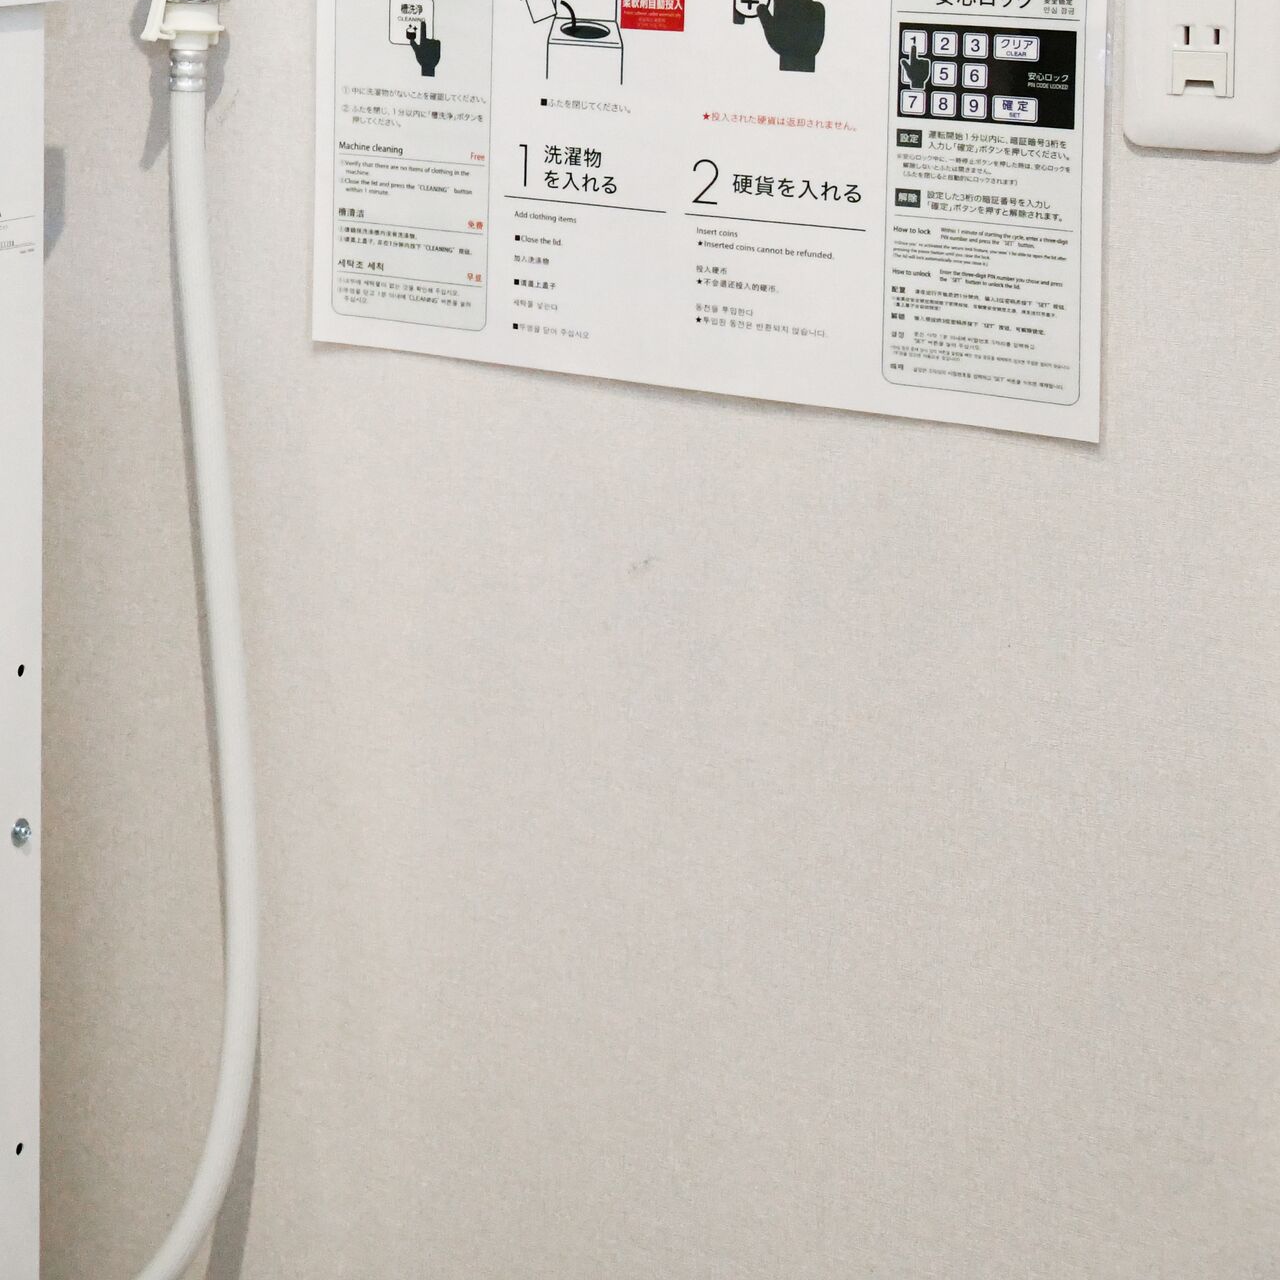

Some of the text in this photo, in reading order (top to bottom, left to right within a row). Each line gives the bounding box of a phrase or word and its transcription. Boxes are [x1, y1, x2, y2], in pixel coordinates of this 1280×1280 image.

[941, 38, 949, 51] 2
[970, 39, 980, 52] 3
[1001, 39, 1033, 50] クリア
[939, 67, 979, 82] 5 6
[1028, 72, 1069, 82] 安心ロック
[908, 95, 1029, 113] 7 8 9 確定
[339, 141, 485, 162] Machine cleaning Free
[519, 144, 602, 187] 1 洗濯物
[544, 170, 618, 195] を入れる
[692, 159, 862, 206] 2 硬貨を入れる
[514, 211, 577, 225] Add clothing items
[696, 227, 738, 238] Insert coins
